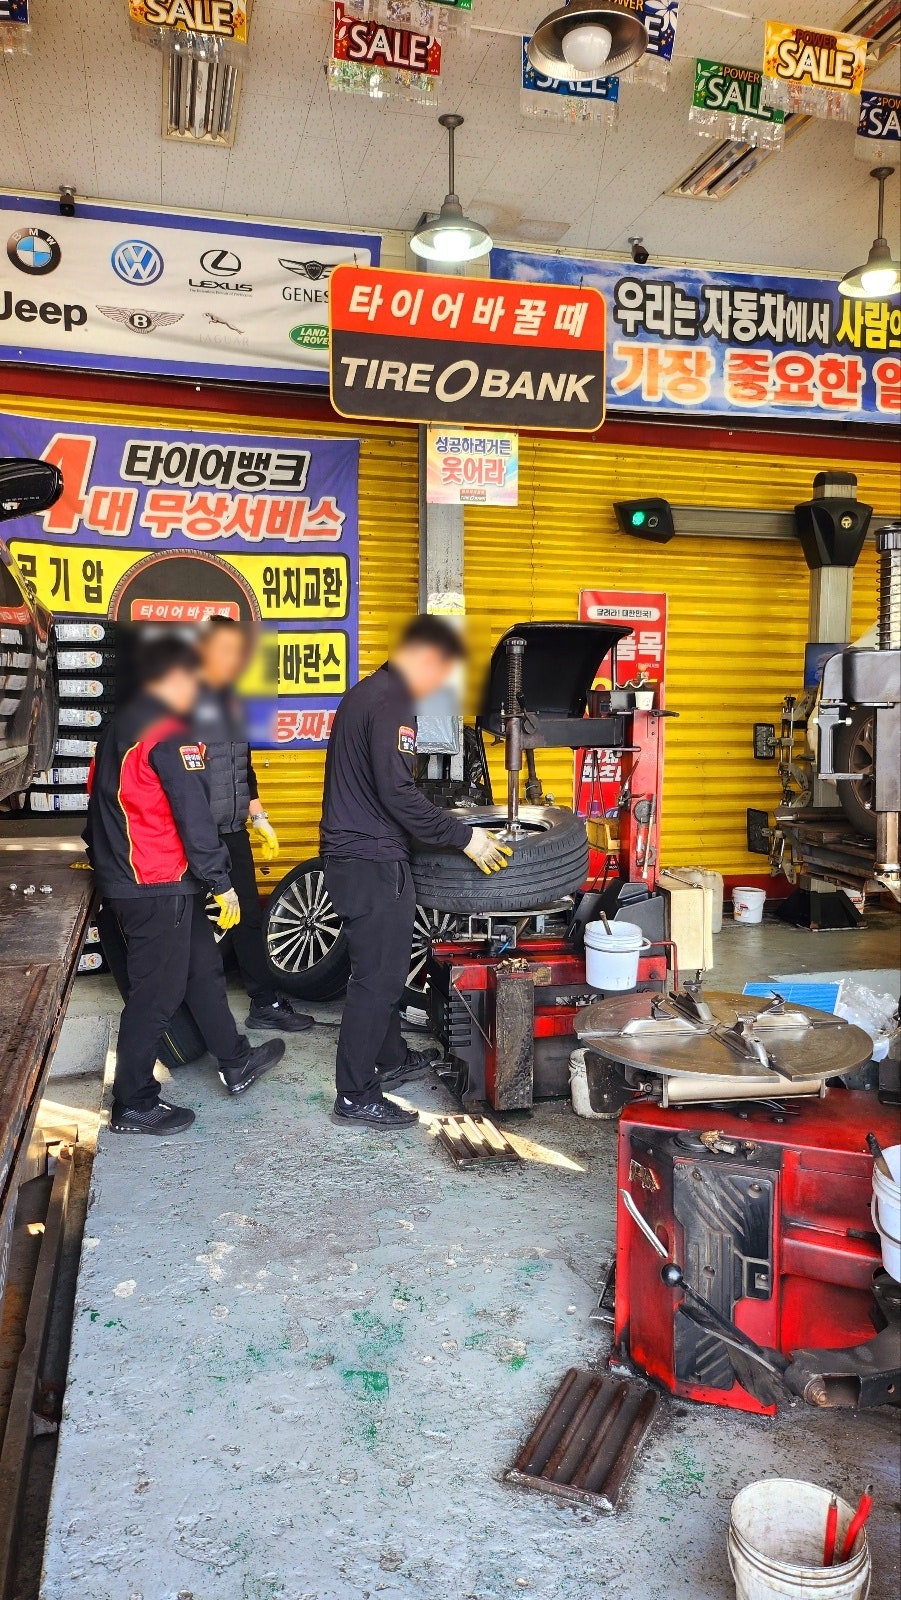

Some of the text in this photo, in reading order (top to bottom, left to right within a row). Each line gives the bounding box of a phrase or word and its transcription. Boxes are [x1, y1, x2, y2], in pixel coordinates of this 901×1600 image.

[144, 0, 233, 36] SALE
[349, 24, 428, 68] SALE
[795, 29, 837, 49] POWER
[723, 66, 760, 83] POWER
[777, 40, 853, 88] SALE
[189, 279, 253, 292] LEXUS
[0, 291, 88, 331] Jeep
[617, 280, 696, 336] 우리는
[702, 289, 830, 344] 자동차에서
[615, 346, 710, 398] 가장
[728, 353, 862, 406] 중요한
[125, 444, 307, 487] 타이어뱅크
[435, 437, 511, 455] 성공하려거든
[42, 437, 135, 531] 4대
[442, 456, 505, 485] 웃어라
[262, 566, 342, 608] 위치교환
[277, 643, 341, 684] 바란스
